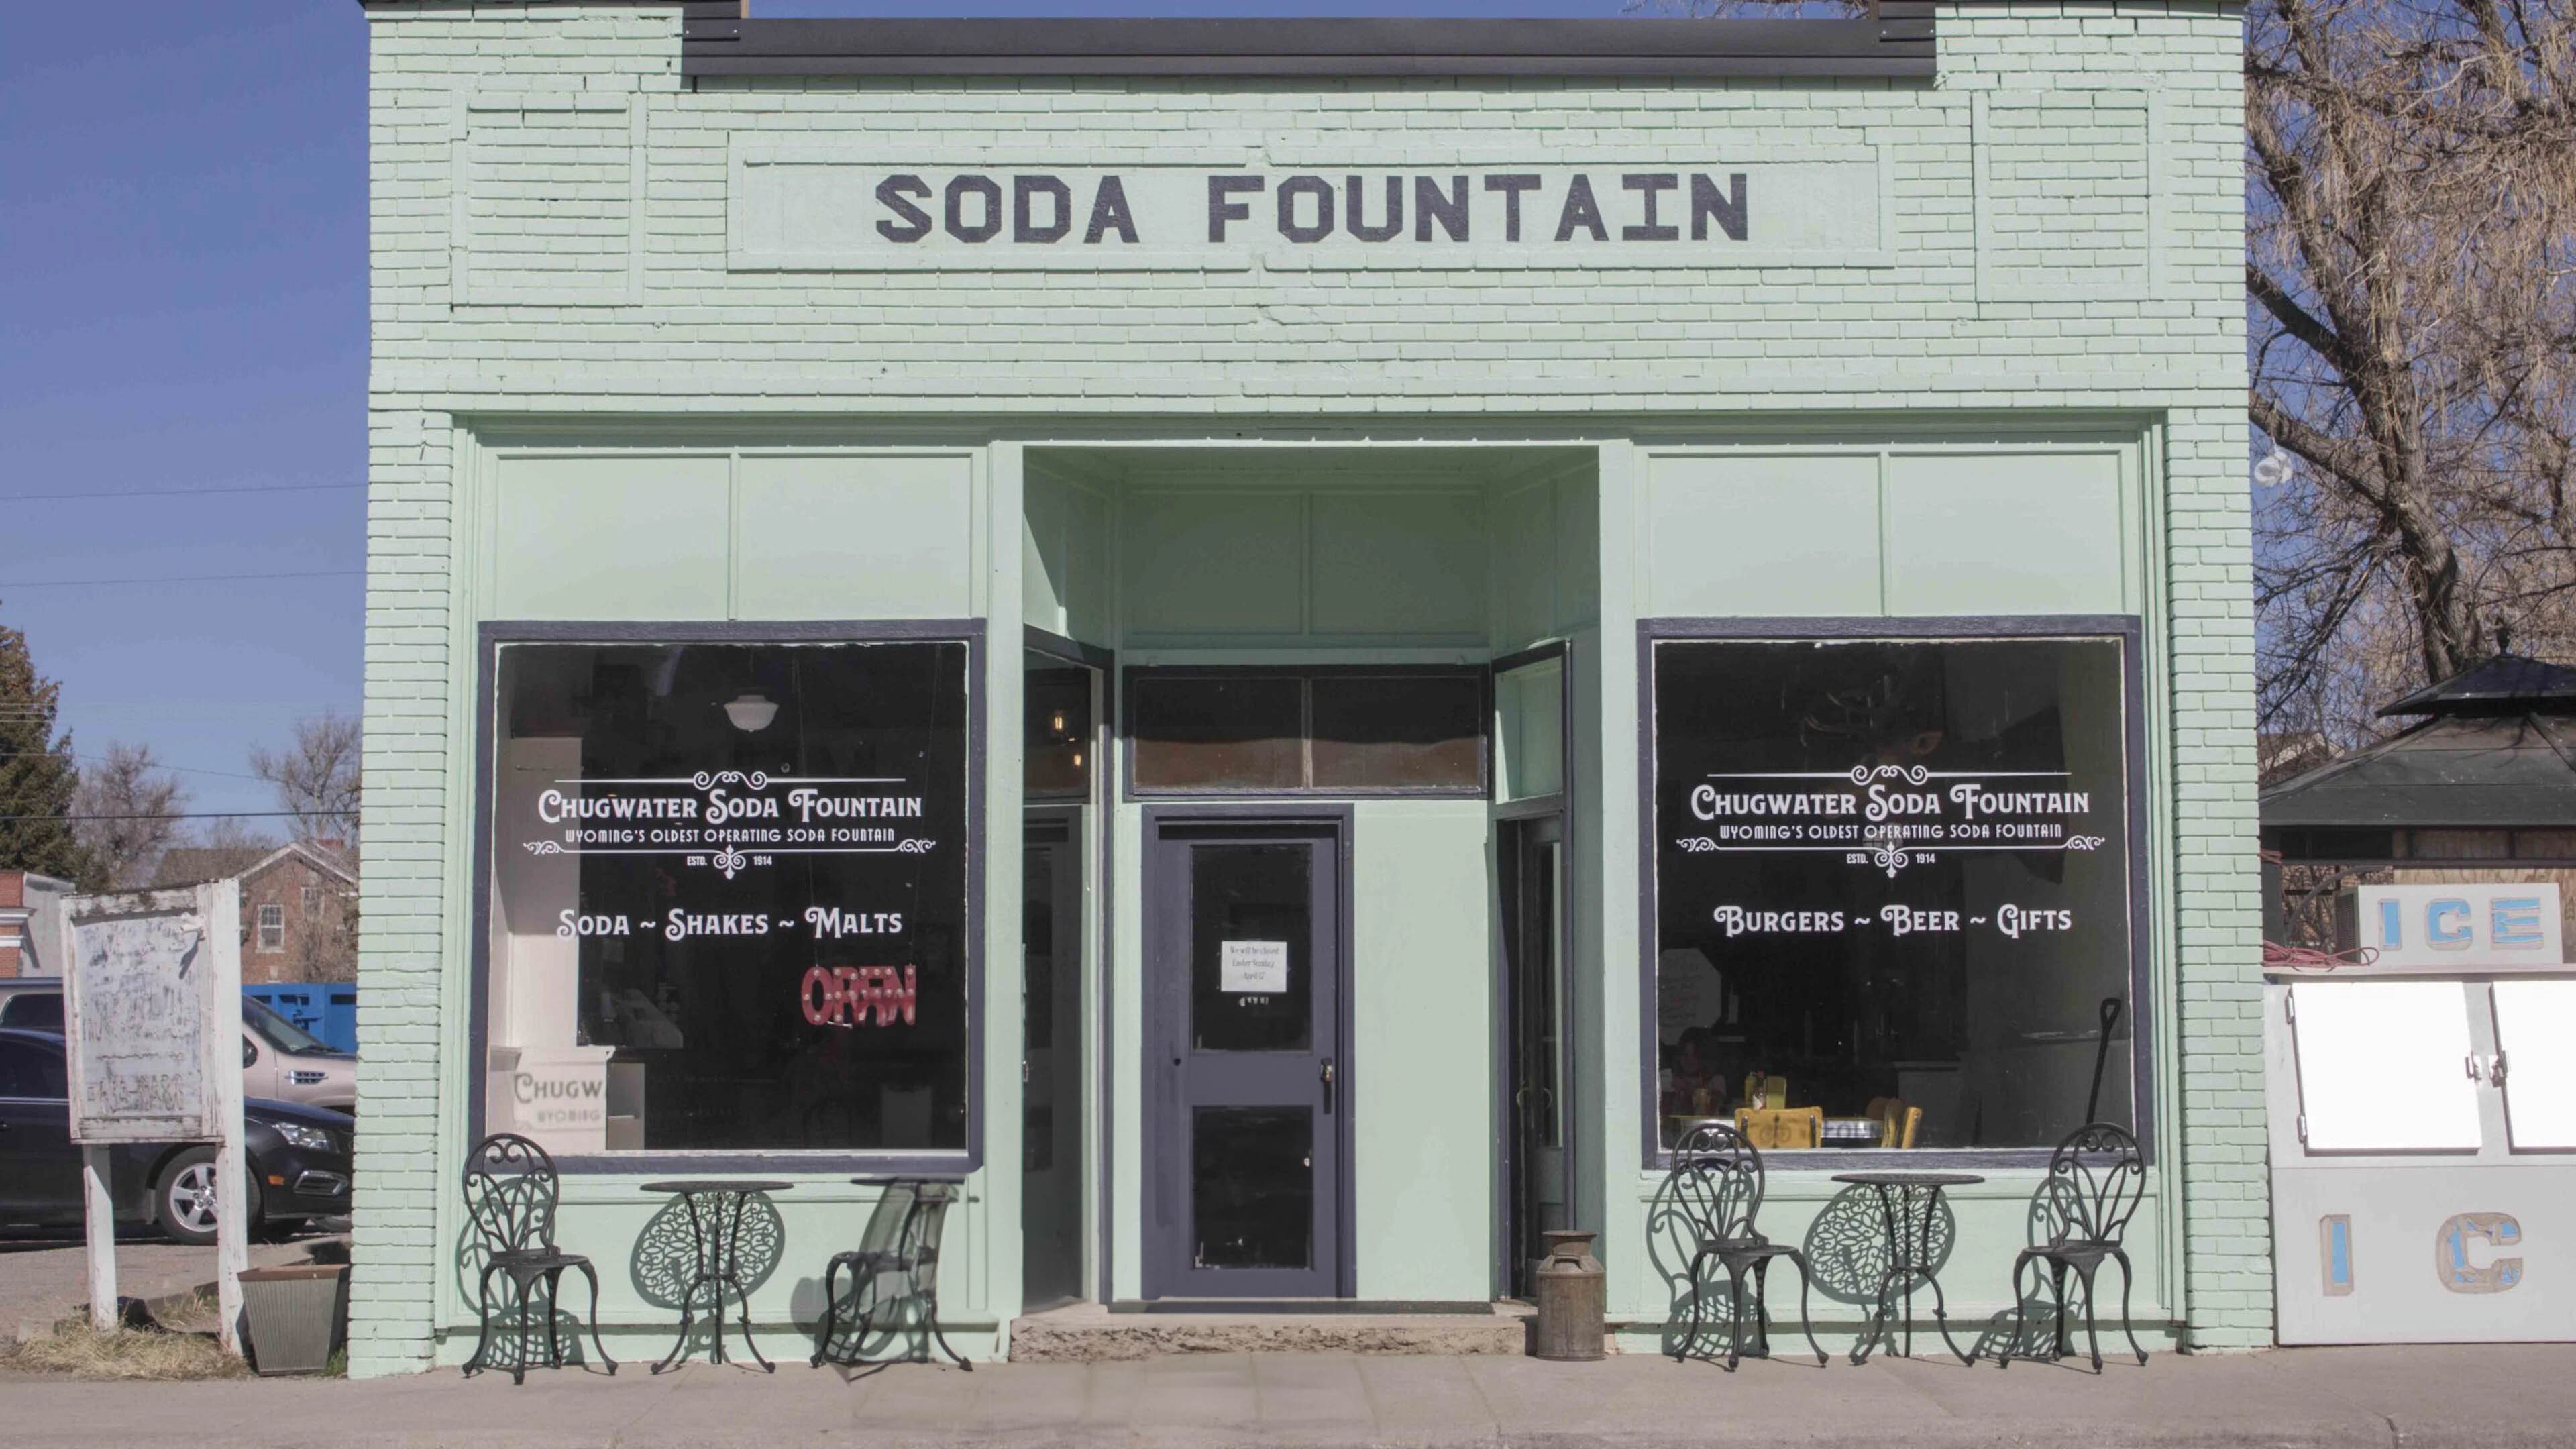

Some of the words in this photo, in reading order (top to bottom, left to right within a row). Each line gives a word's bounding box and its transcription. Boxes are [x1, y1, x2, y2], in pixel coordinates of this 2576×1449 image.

[876, 175, 1139, 244] SODA
[1209, 173, 1748, 244] FOUNTAIN
[538, 789, 698, 824] CHUGWATER
[706, 788, 780, 825] SODA
[788, 788, 922, 824] FOUNTAIN
[1690, 784, 1856, 821] CHUGWATER
[1865, 784, 1941, 822] SODA
[1949, 783, 2090, 820] FOUNTAIN
[565, 829, 645, 843] WYOMING'S
[650, 829, 699, 843] OLDEST
[704, 828, 782, 843] OPERATING
[787, 828, 825, 842] SODA
[831, 828, 894, 842] FOUNTAIN
[1720, 825, 1803, 839] WYOMING'S
[1808, 825, 1859, 839] OLDEST
[1864, 824, 1944, 839] OPERATING
[1950, 824, 1990, 838] SODA
[1996, 824, 2061, 838] FOUNTAIN
[686, 855, 708, 866] ESTD.
[753, 855, 773, 866] 1914
[1846, 853, 1868, 864] ESTD.
[1915, 853, 1935, 864] 1914
[556, 909, 630, 941] SODA
[665, 908, 769, 941] SHAKES
[804, 906, 902, 938] MALTS
[1713, 905, 1844, 938] BURGERS
[1880, 904, 1960, 937] BEER
[1997, 903, 2072, 939] GIFTS
[2378, 897, 2544, 951] ICE
[801, 965, 916, 1026] OPEN
